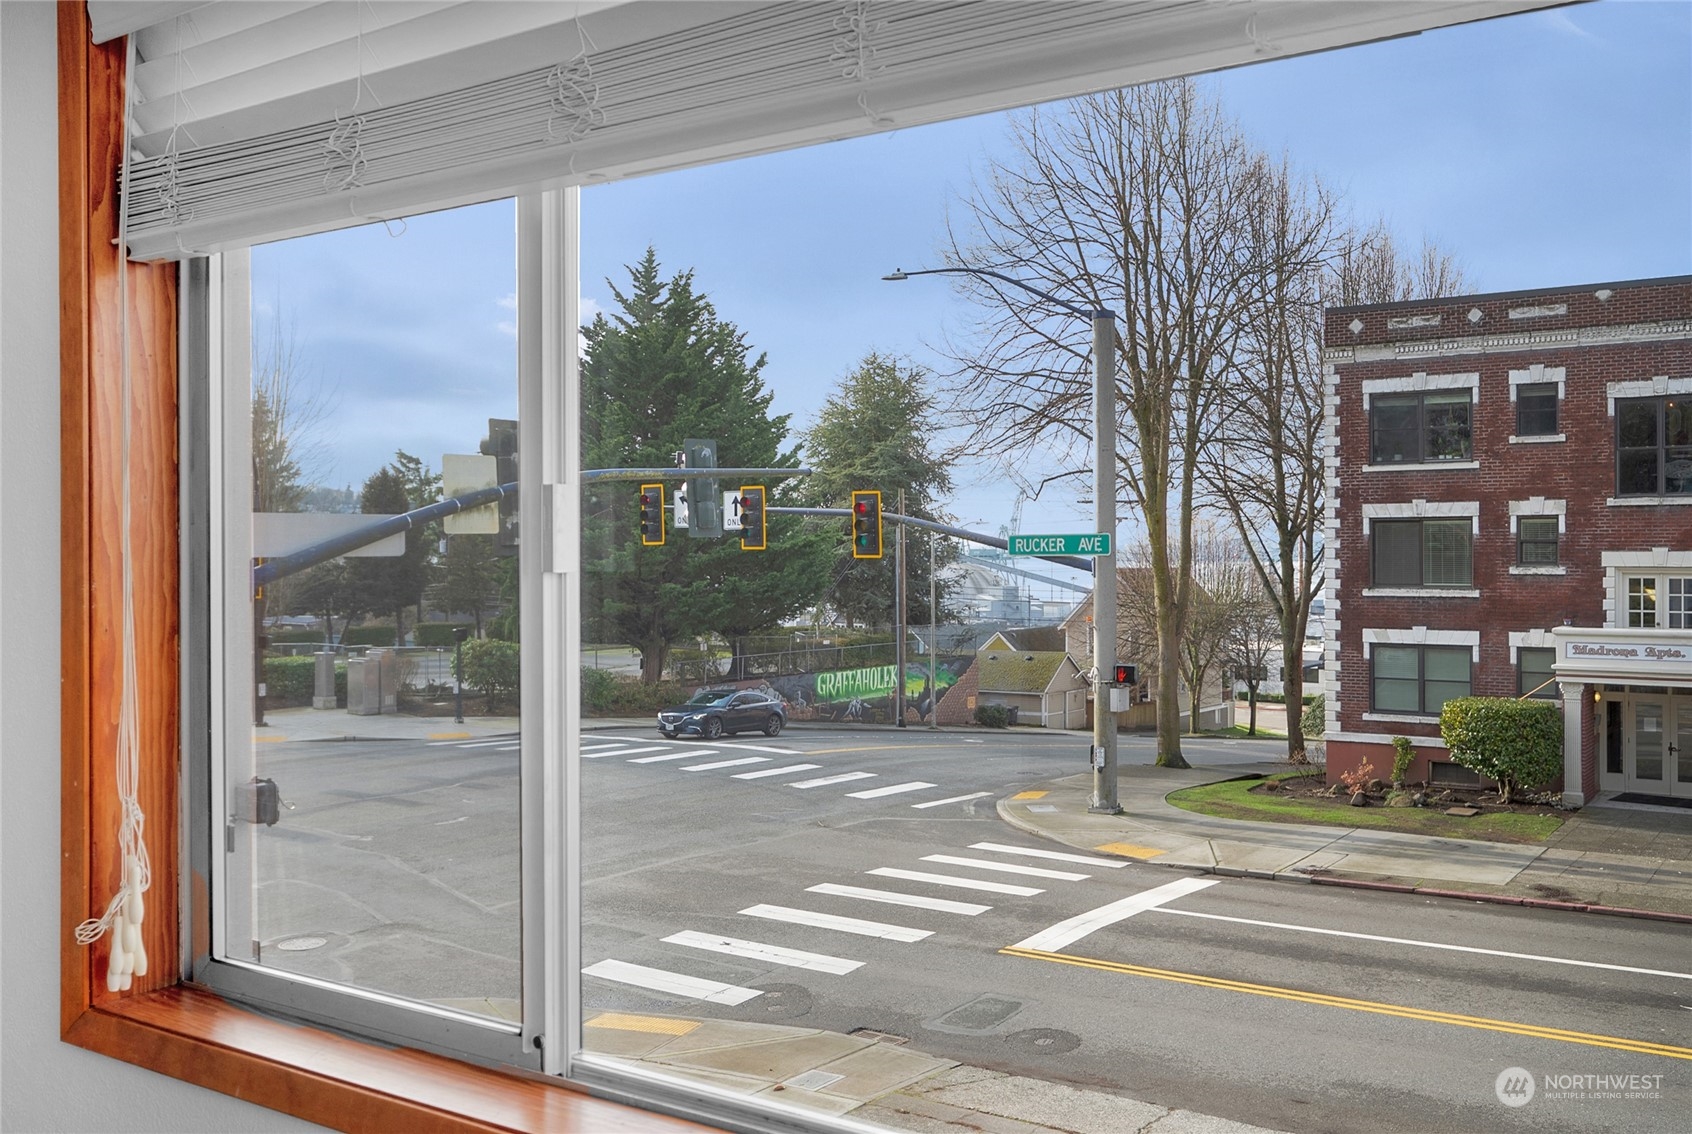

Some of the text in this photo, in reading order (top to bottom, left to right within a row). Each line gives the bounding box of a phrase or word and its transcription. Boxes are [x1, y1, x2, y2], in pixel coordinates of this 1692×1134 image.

[727, 518, 741, 526] ONL
[1015, 537, 1103, 552] RUCKER AVE
[1572, 645, 1639, 658] Madrona
